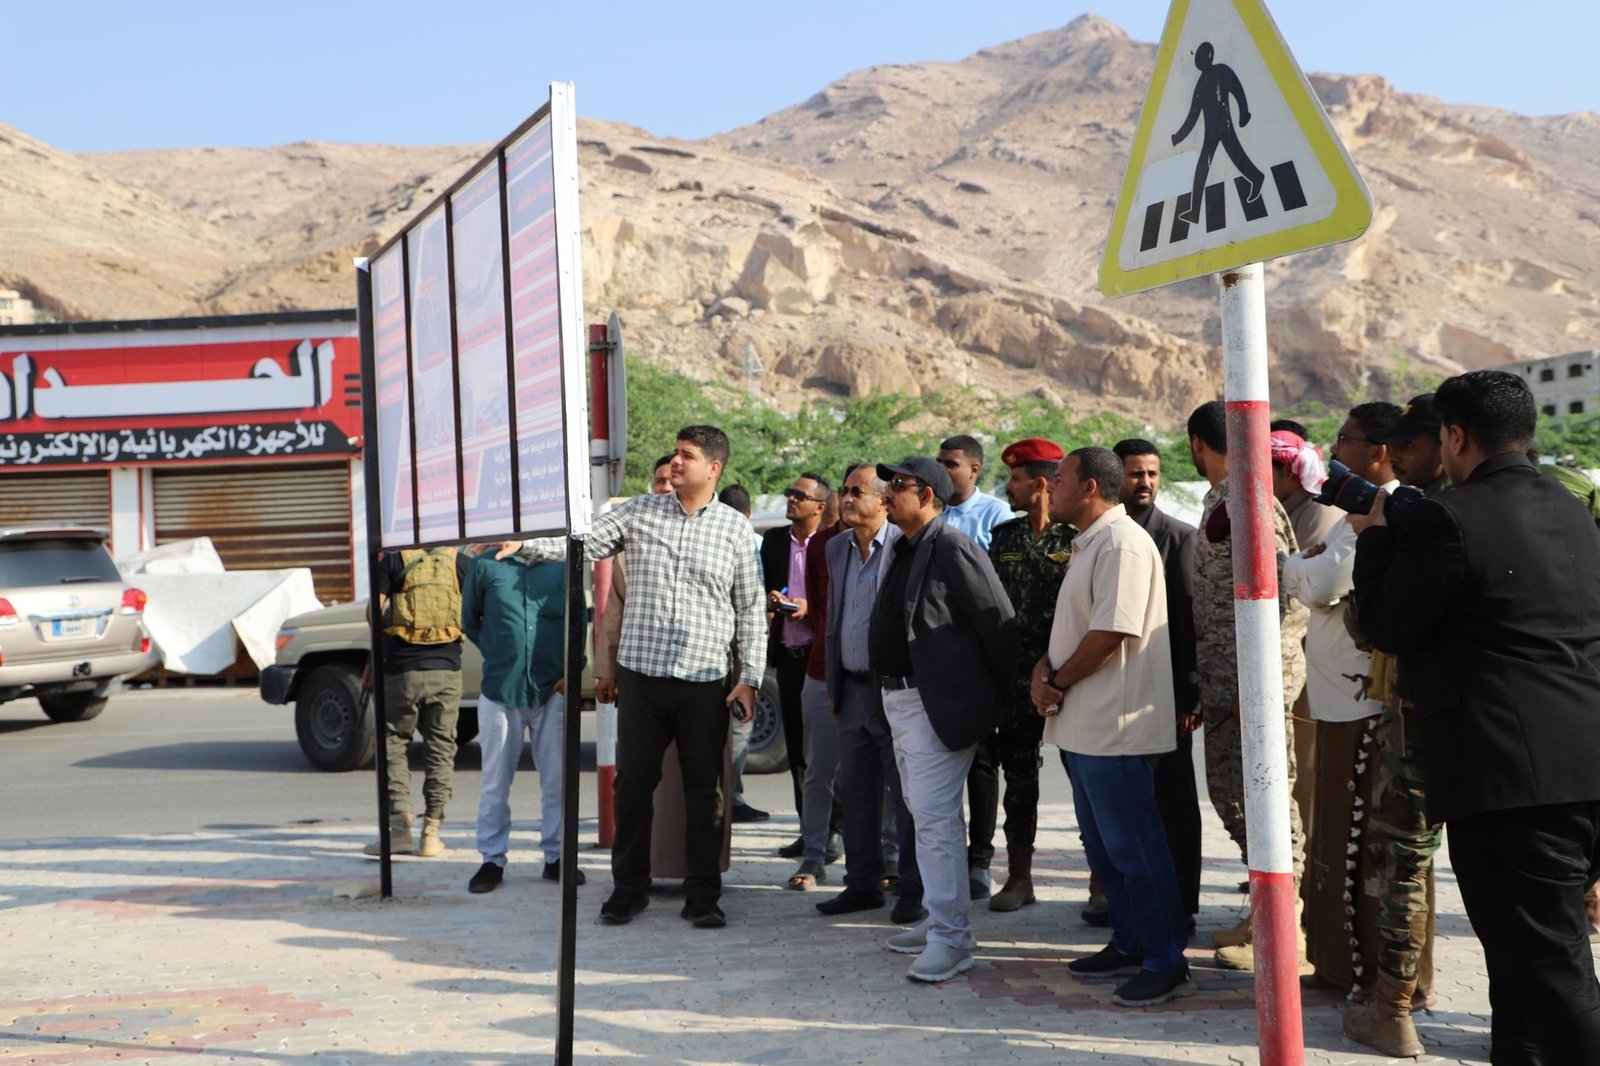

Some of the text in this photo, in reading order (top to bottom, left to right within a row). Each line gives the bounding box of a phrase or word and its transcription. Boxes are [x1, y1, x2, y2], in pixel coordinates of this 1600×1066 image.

[0, 419, 326, 465] للأجهزة الكهربائية والإلكتروني
